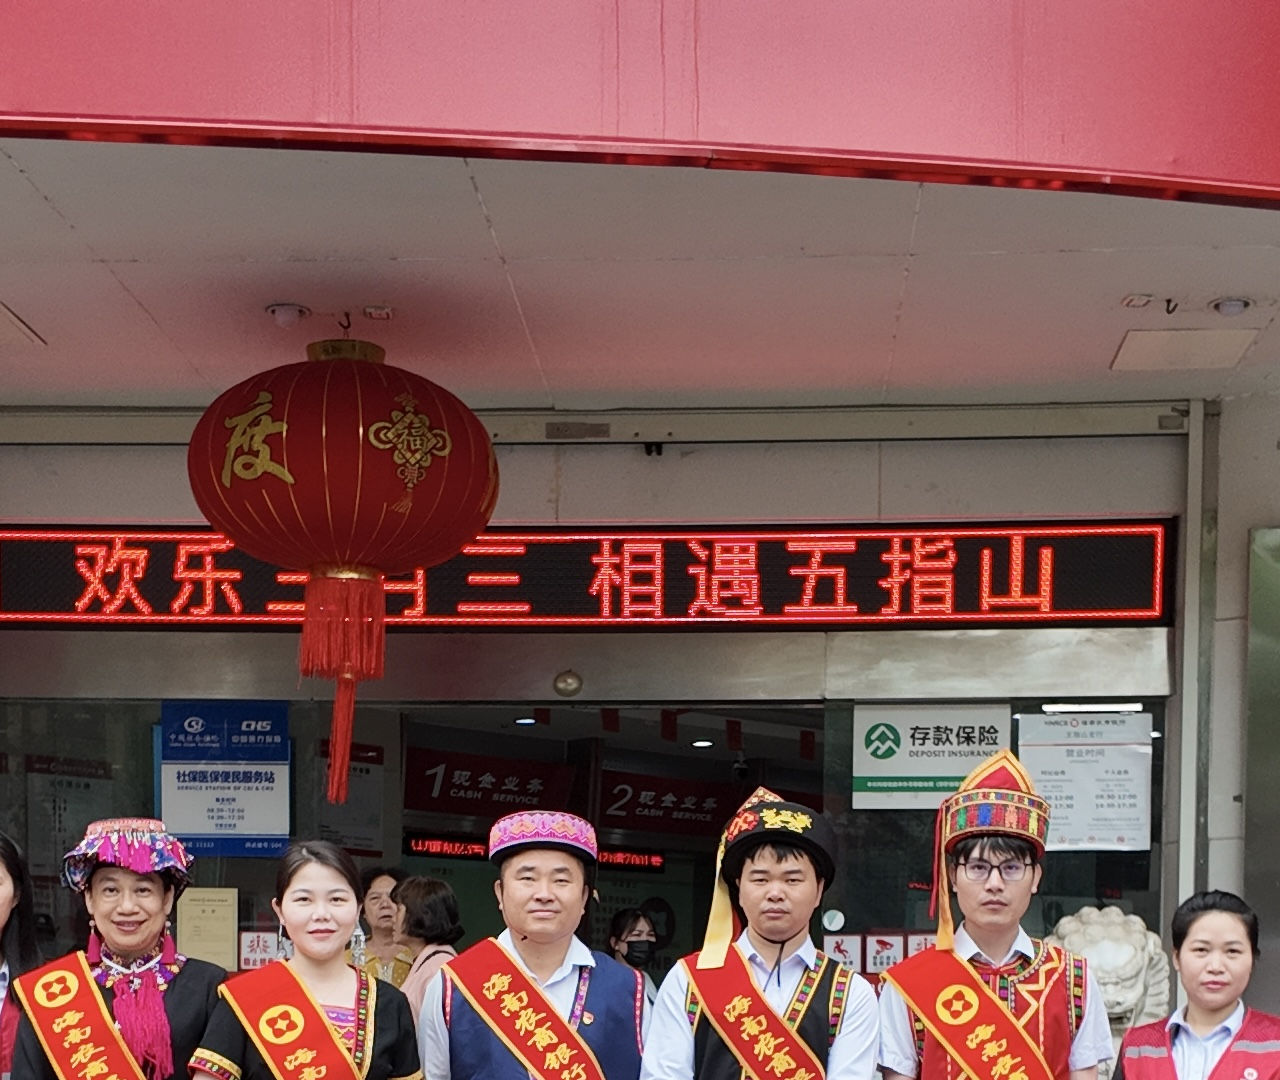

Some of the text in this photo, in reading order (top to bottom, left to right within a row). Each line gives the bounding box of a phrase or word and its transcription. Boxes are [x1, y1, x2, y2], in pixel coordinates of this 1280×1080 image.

[222, 391, 295, 487] 度
[74, 534, 1058, 618] 欢乐三 相遇五指山
[909, 725, 1000, 746] 存款保险
[909, 749, 998, 758] DEPOSIT INSURANC
[176, 770, 275, 784] 社保医保便民服务站
[425, 763, 545, 798] 1 现金业务
[450, 788, 540, 805] CASH SERVICE
[606, 784, 633, 816] 2
